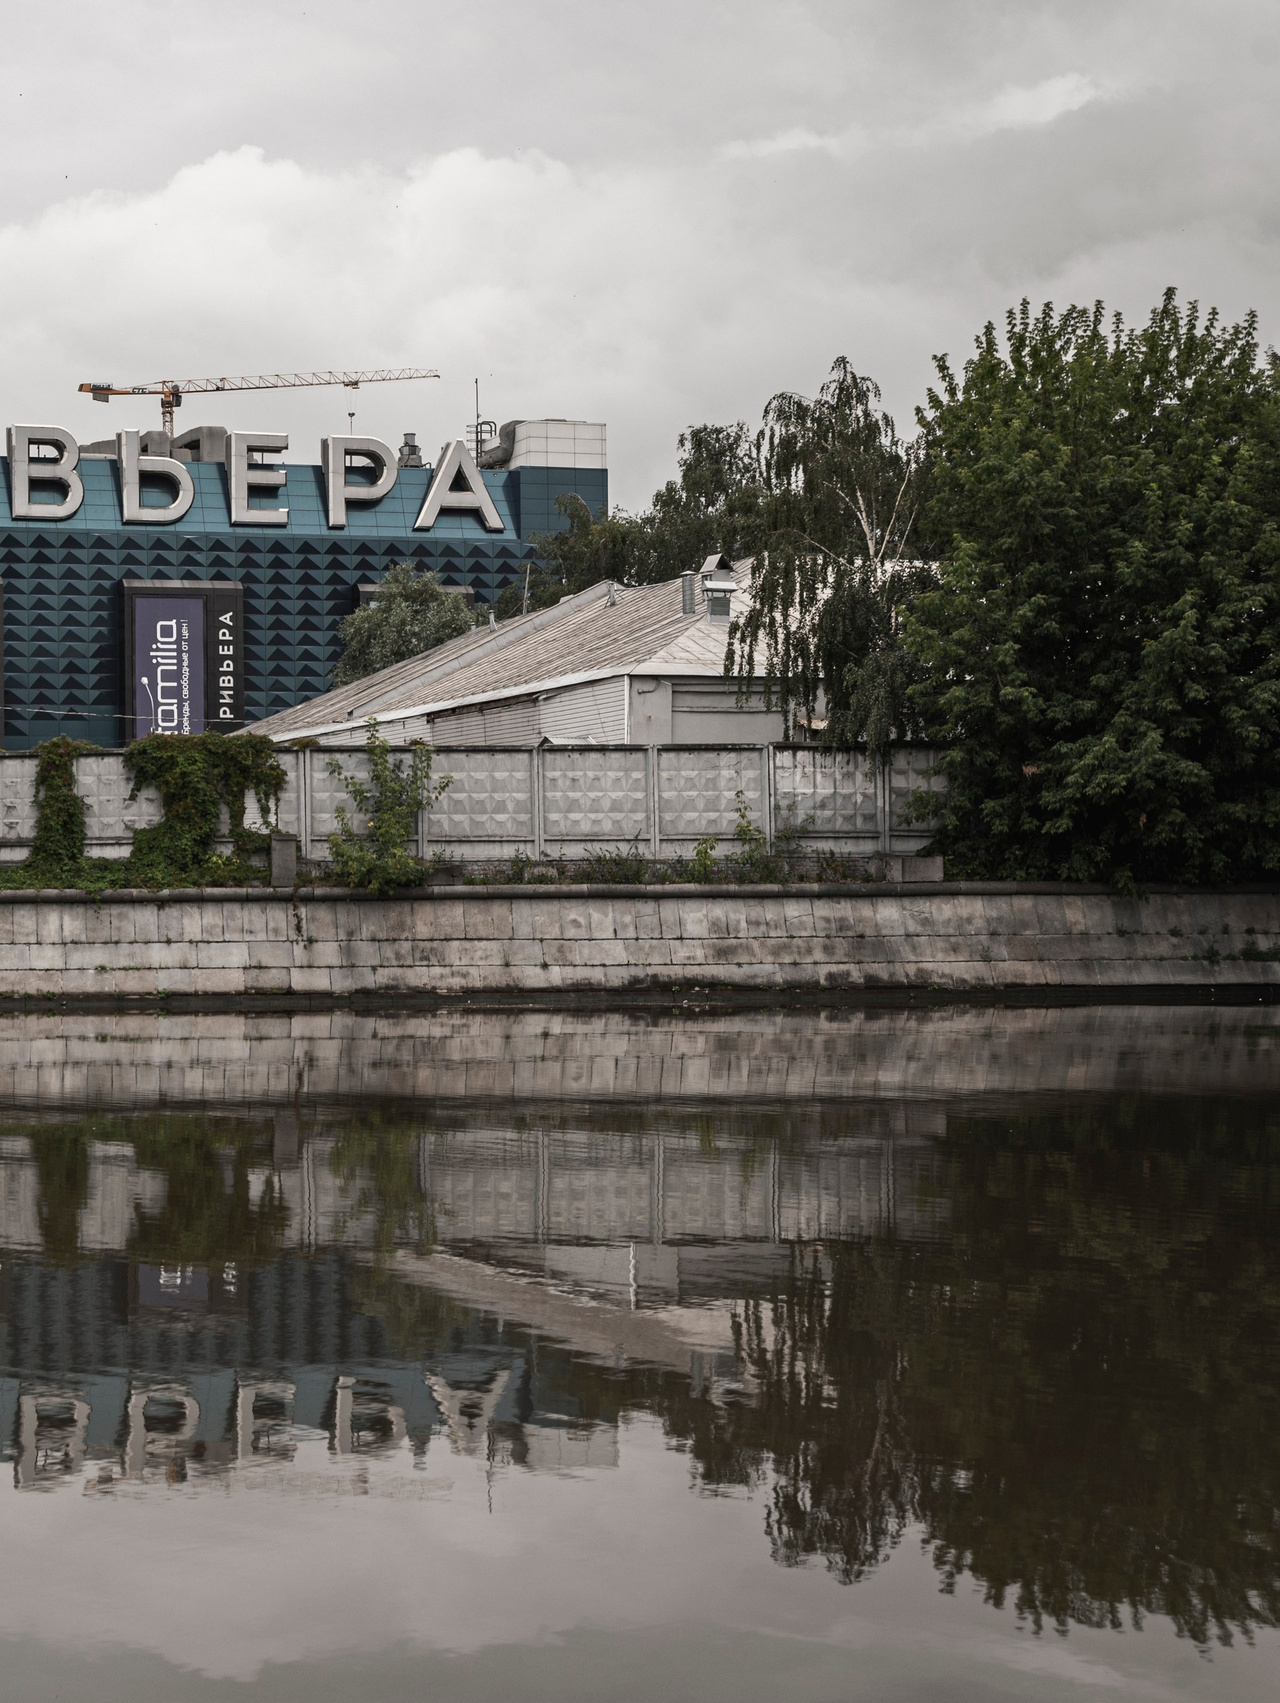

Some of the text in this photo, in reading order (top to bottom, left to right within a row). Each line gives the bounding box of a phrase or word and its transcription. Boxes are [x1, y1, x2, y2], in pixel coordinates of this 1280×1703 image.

[181, 640, 189, 651] от
[219, 611, 234, 719] РИВЬЕРА
[180, 652, 190, 699] свободные
